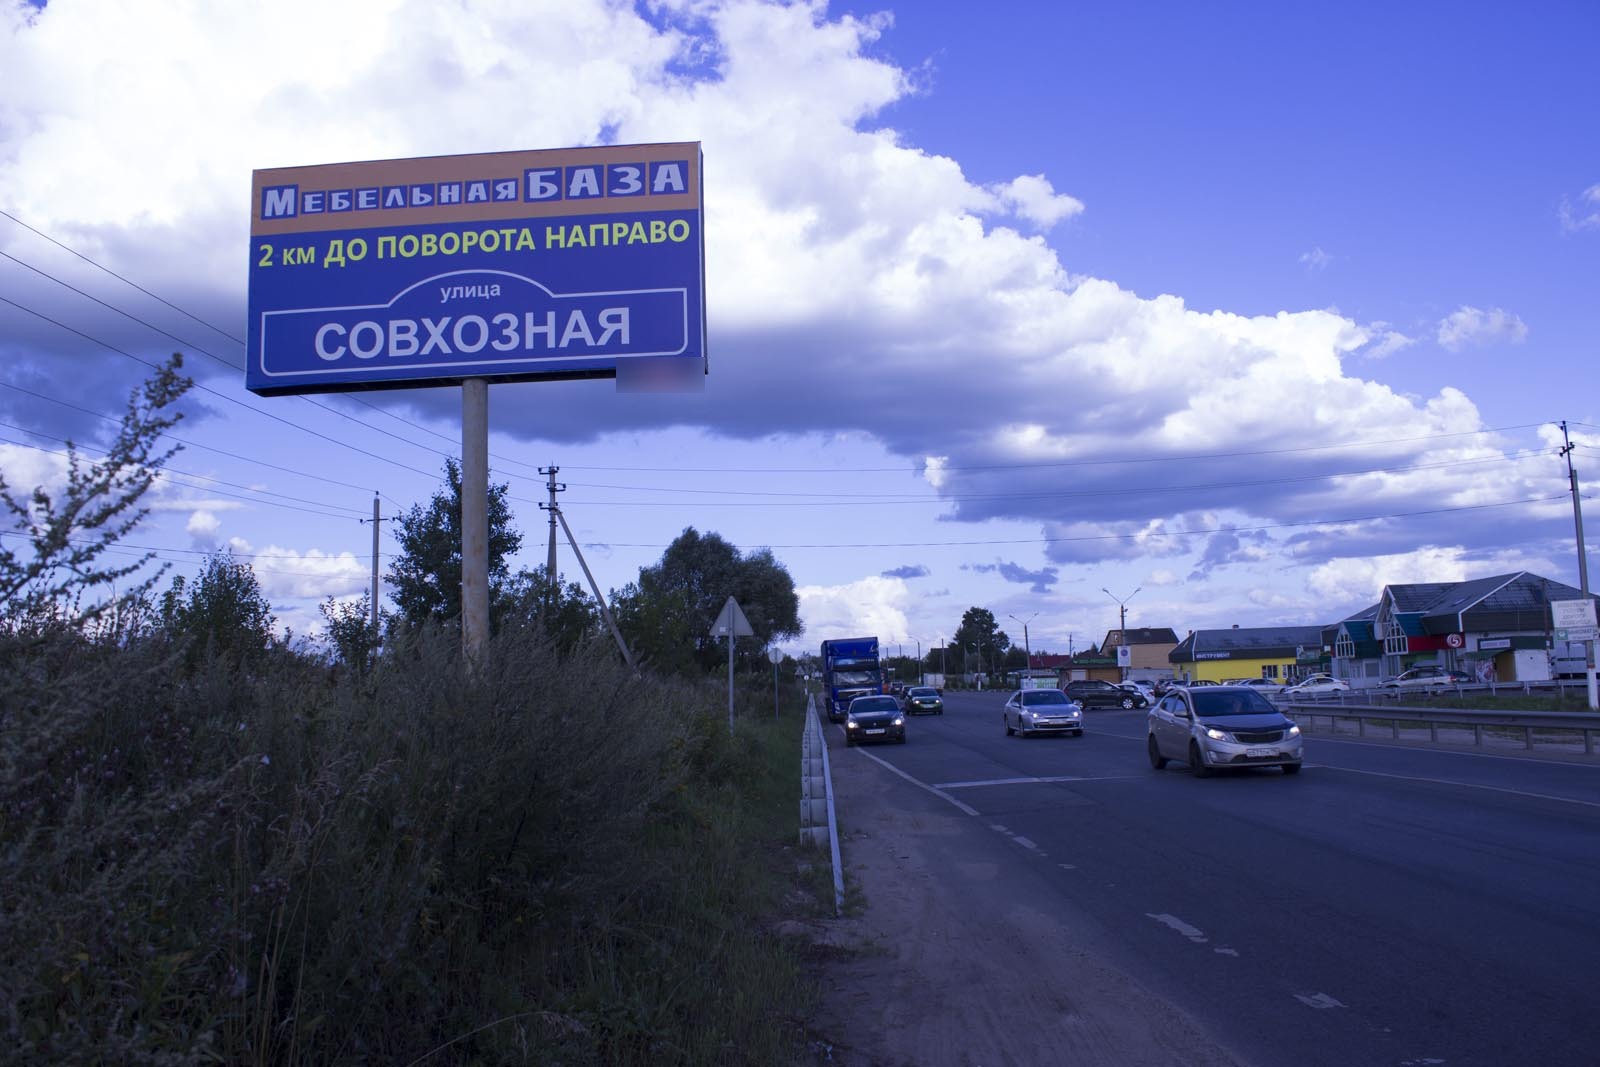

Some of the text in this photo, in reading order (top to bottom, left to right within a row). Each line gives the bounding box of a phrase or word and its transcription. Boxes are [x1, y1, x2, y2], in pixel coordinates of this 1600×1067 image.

[527, 164, 685, 199] БАЗА
[258, 244, 273, 267] 2
[323, 238, 368, 269] ДО
[377, 228, 536, 259] ПОВОРОТА
[545, 219, 690, 249] НАПРАВО
[440, 284, 501, 303] улица
[314, 307, 630, 361] СОВХОЗНАЯ
